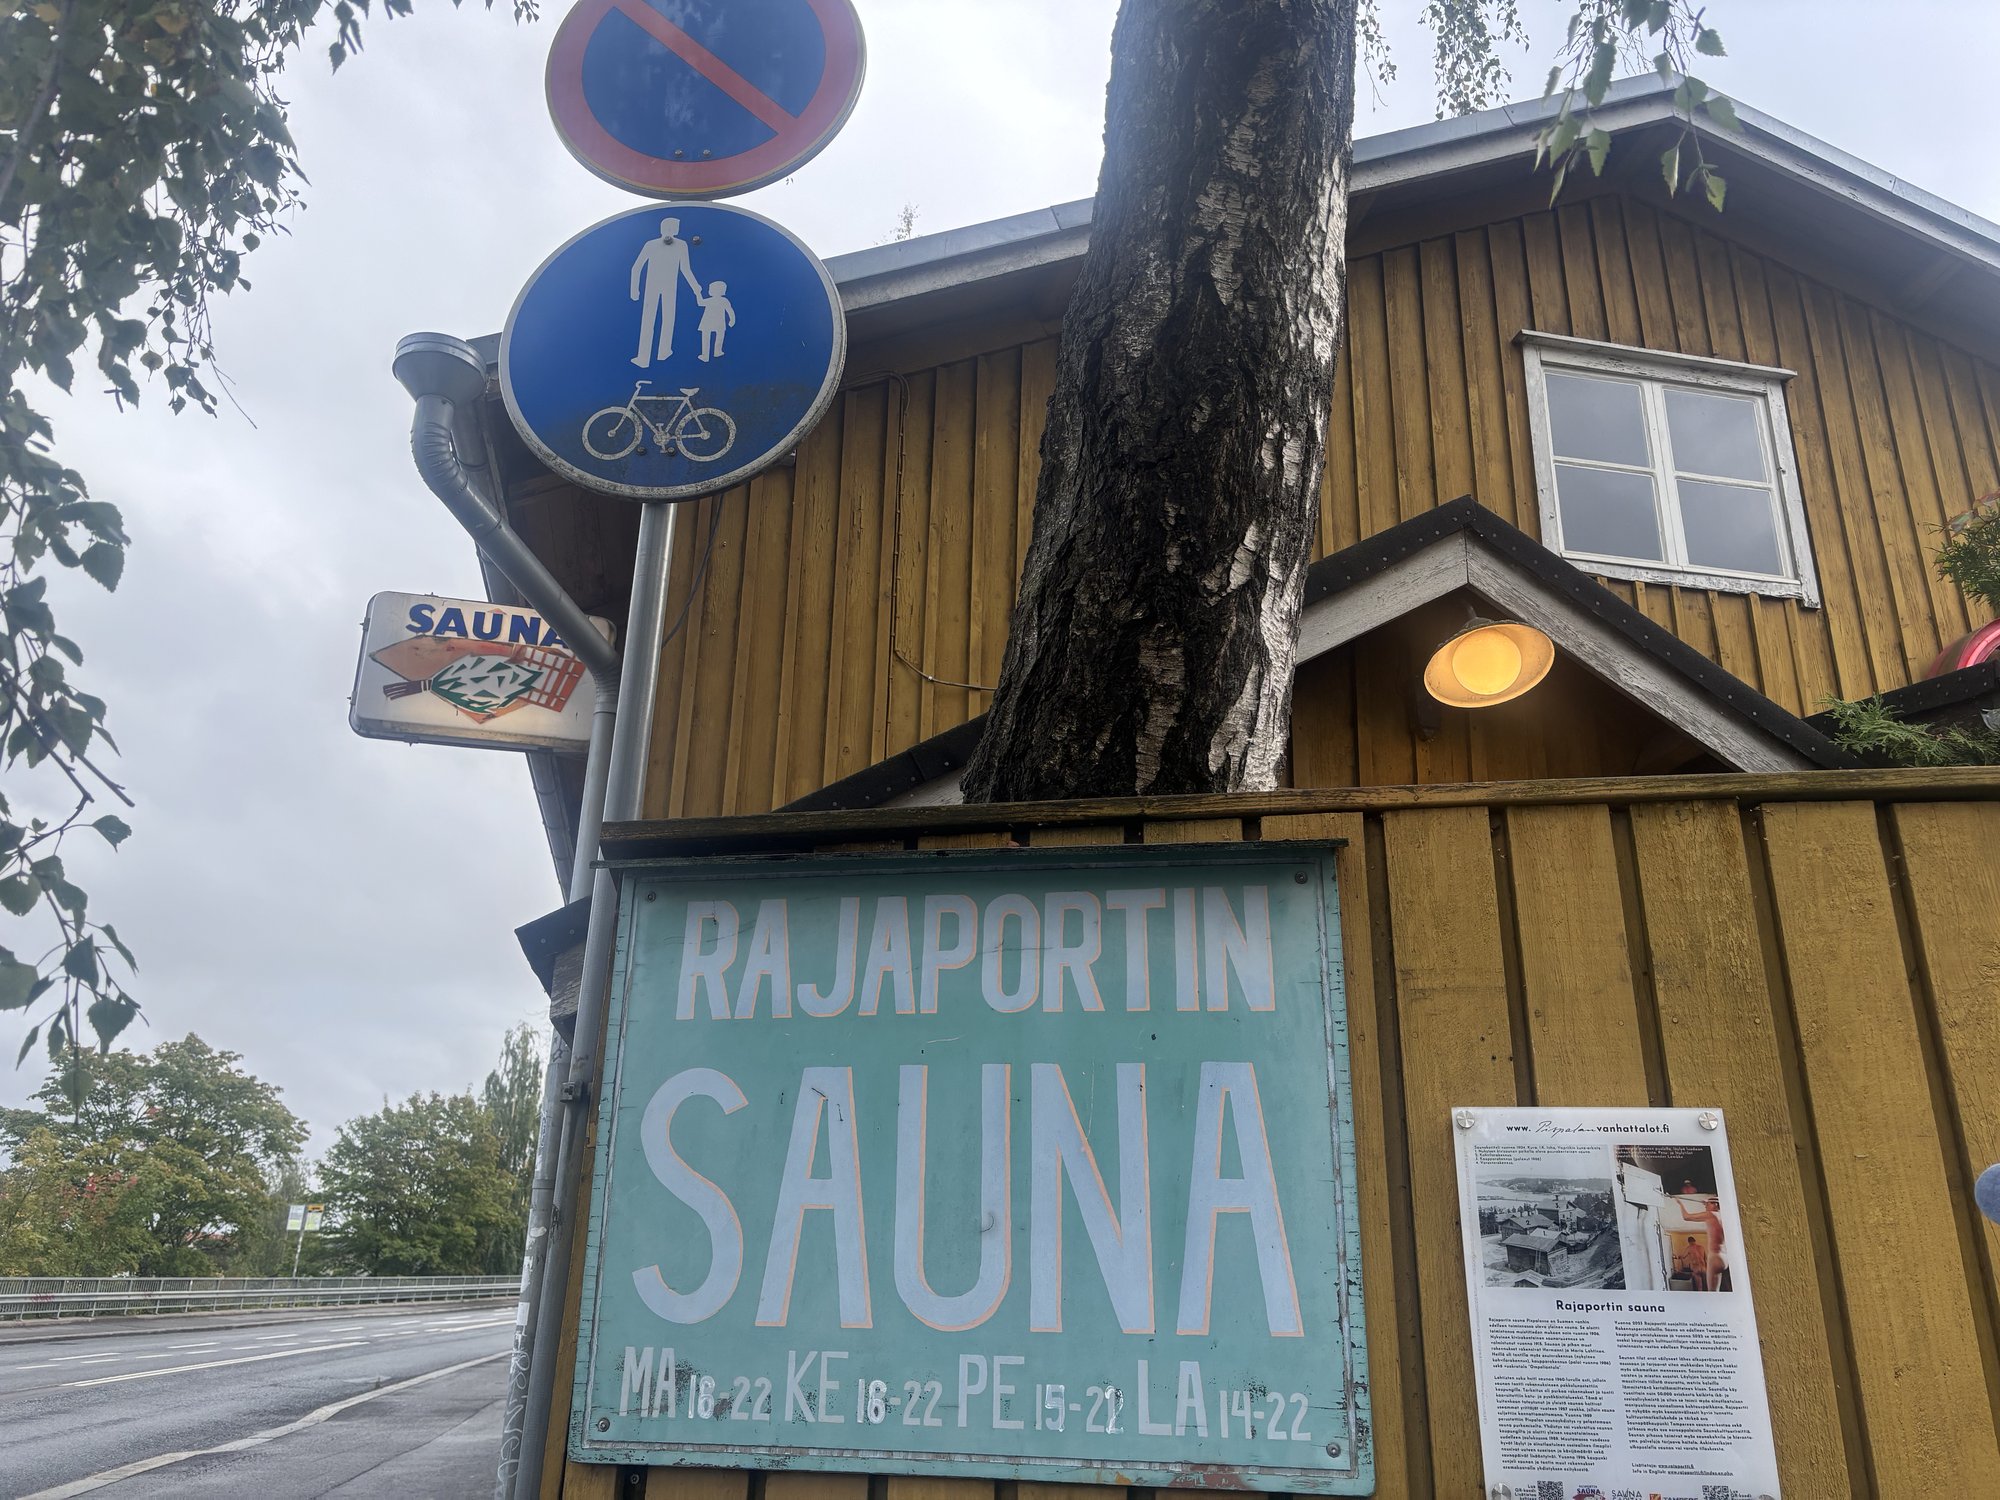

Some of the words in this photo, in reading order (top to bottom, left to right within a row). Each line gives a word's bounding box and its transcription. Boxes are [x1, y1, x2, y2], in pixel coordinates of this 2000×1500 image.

[676, 886, 1275, 1020] RAJAPORTIN
[632, 1063, 1304, 1337] SAUNA
[1556, 1300, 1623, 1313] Rajaportin
[1628, 1304, 1665, 1312] sauna
[619, 1346, 676, 1417] MA
[784, 1350, 849, 1424] KE
[957, 1354, 1024, 1430] PE
[1138, 1359, 1208, 1437] LA
[1219, 1389, 1312, 1441] 14-22
